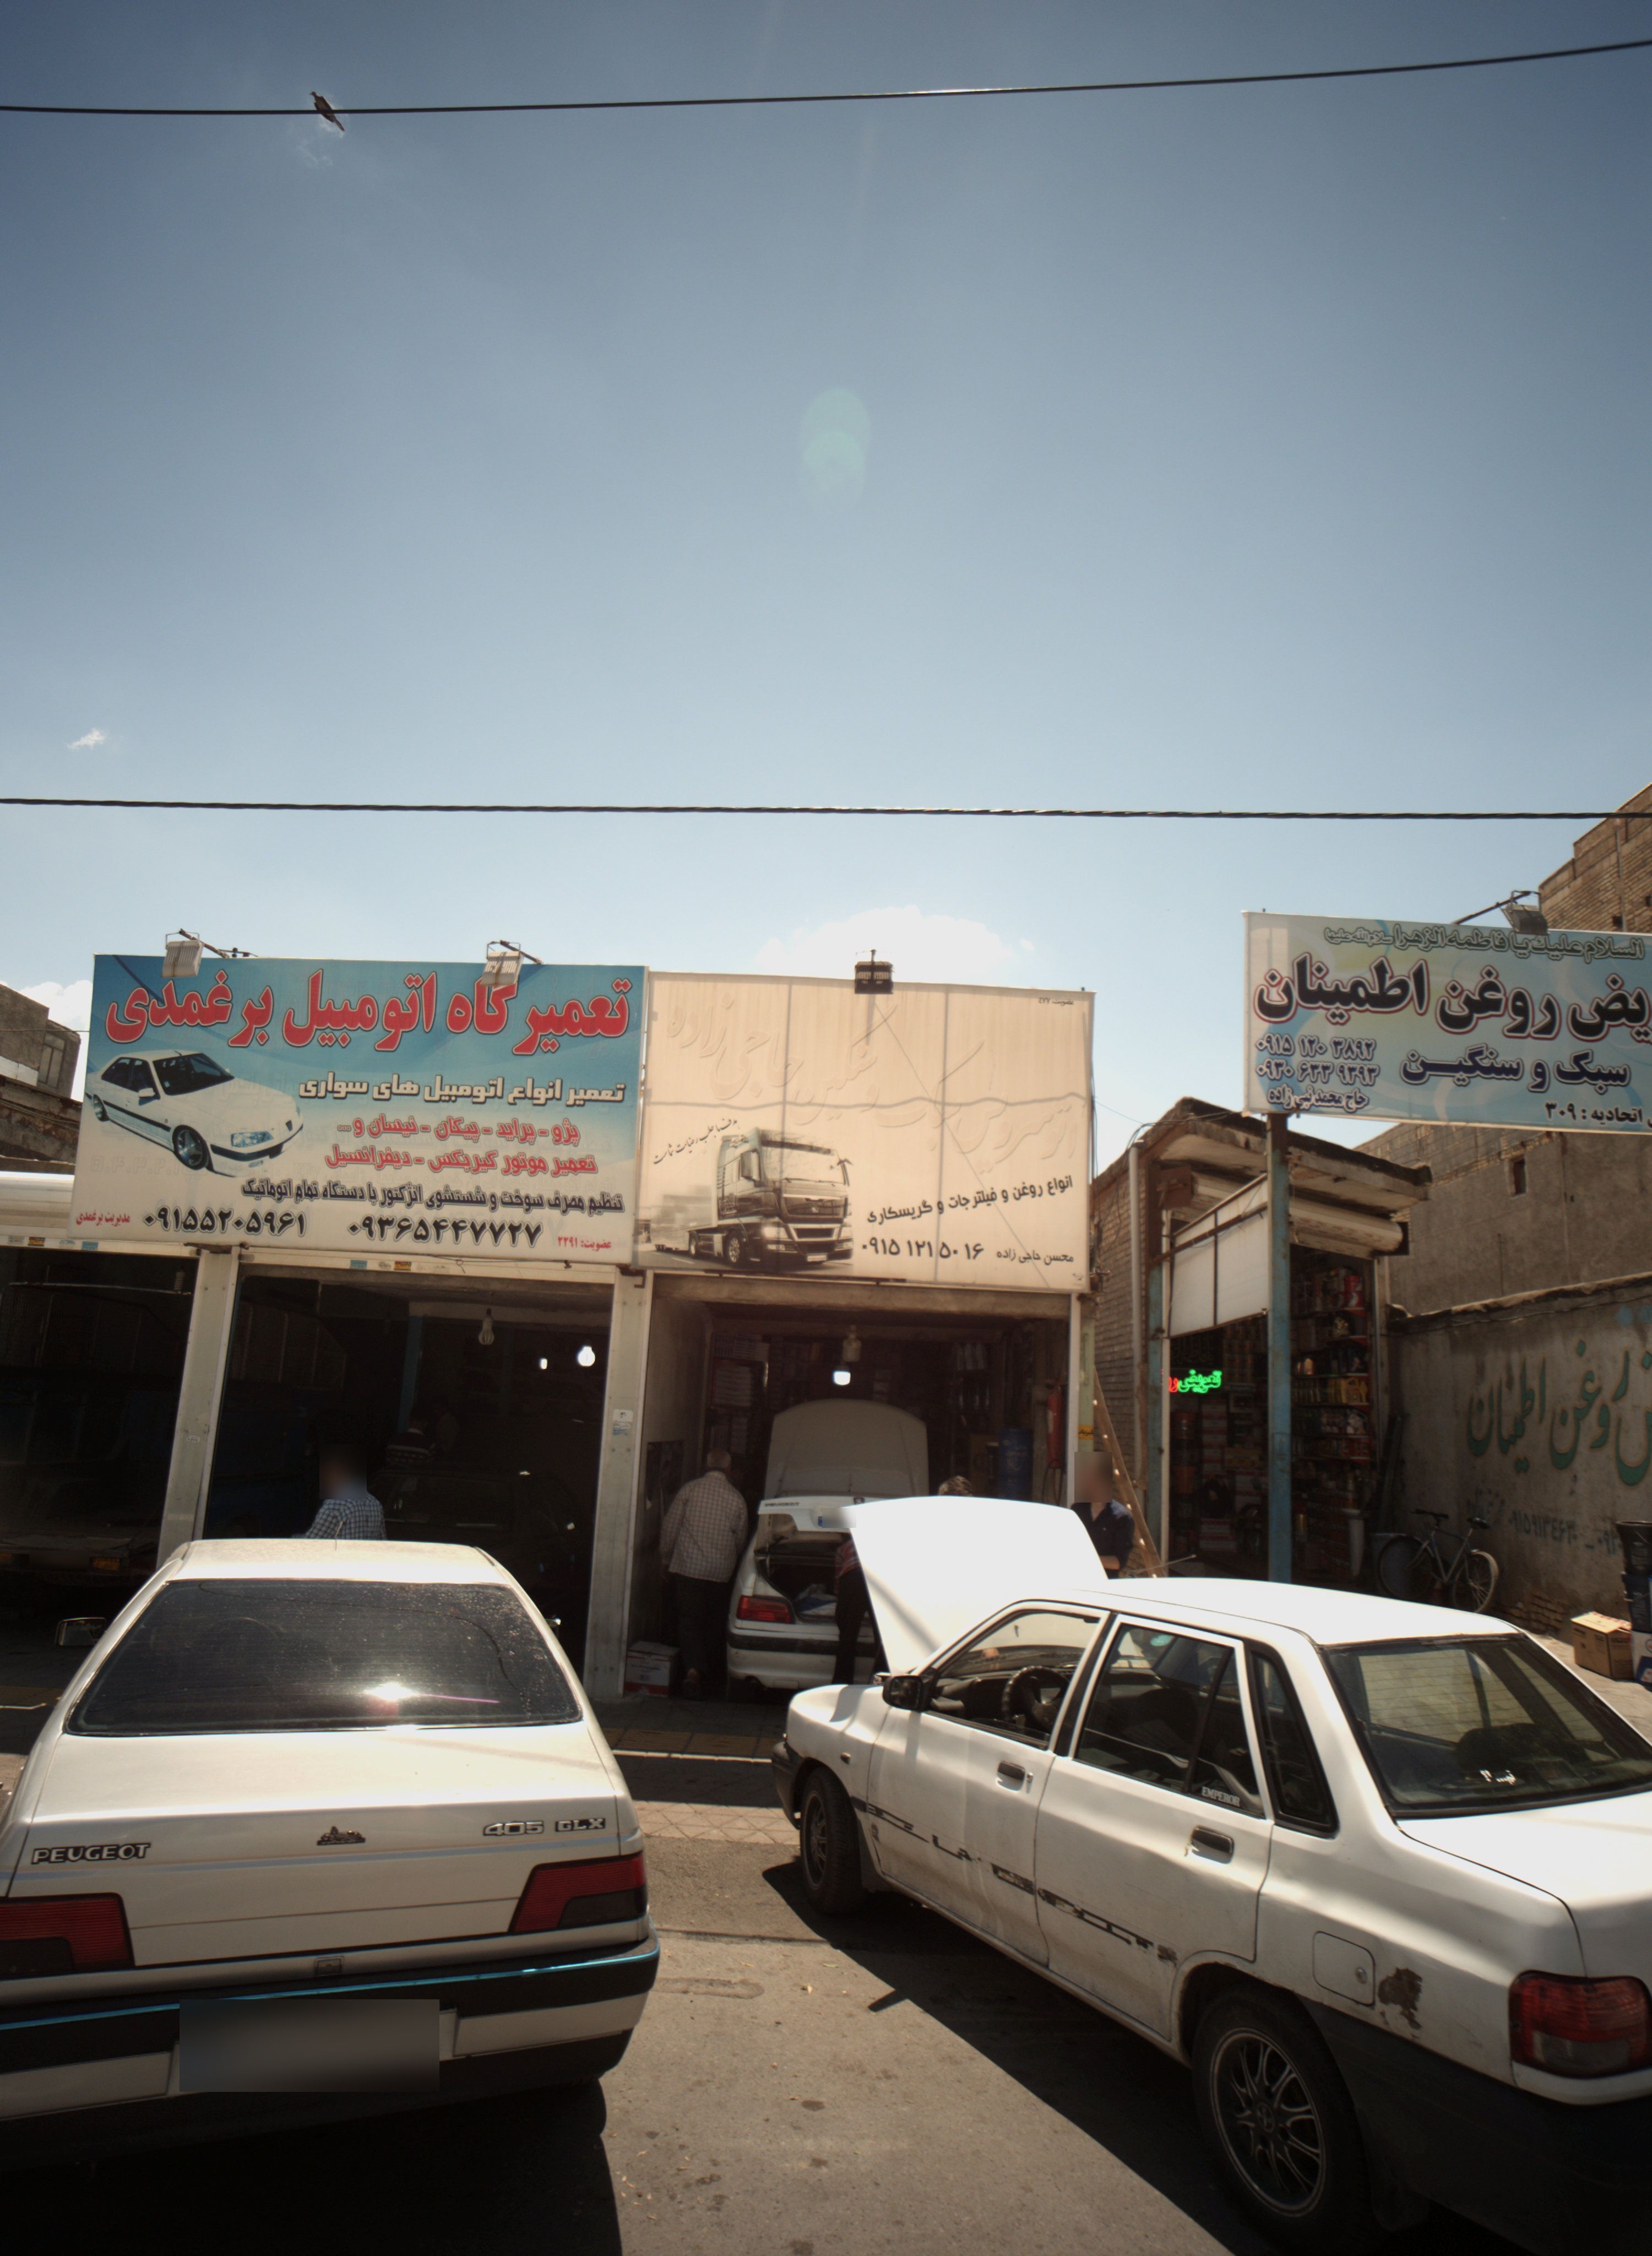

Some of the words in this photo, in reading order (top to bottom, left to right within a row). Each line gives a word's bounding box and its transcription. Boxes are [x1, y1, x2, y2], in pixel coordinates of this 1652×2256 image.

[1253, 952, 1431, 1026] اطمینان
[282, 968, 437, 1051] اتومبیل
[1436, 965, 1562, 1041] روغن
[1400, 1043, 1524, 1086] سنگین
[1528, 1060, 1551, 1092] و
[1554, 1049, 1631, 1094] سبک
[298, 1071, 369, 1099] سواری
[372, 1073, 419, 1100] های
[423, 1075, 504, 1103] اتومبیل
[507, 1077, 562, 1105] انواع
[566, 1082, 626, 1107] تعمیر
[1545, 1102, 1577, 1121] ۳۰۹
[1590, 1107, 1643, 1125] اتحادیه
[352, 1118, 365, 1137] و
[367, 1113, 419, 1138] نیسان
[434, 1115, 480, 1143] پیکان
[496, 1118, 537, 1145] پراید
[551, 1118, 581, 1146] پژو
[325, 1143, 412, 1170] دیفرانسیل
[502, 1152, 549, 1176] موتور
[551, 1155, 599, 1178] تعمیر
[241, 1178, 294, 1203] اتوماتیک
[294, 1179, 319, 1203] تمام
[321, 1179, 367, 1201] دستگاه
[366, 1181, 378, 1206] با
[379, 1181, 424, 1208] انژکتور
[425, 1184, 488, 1210] شستشوی
[1001, 1189, 1009, 1203] و
[1012, 1181, 1044, 1201] روغن
[1047, 1175, 1074, 1196] انواع
[499, 1188, 545, 1214] سوخت
[546, 1190, 586, 1216] مصرف
[587, 1189, 626, 1217] تنظیم
[143, 1205, 307, 1237] ۰۹۱۵۵۲۰۵۹۶۱
[348, 1214, 544, 1248] ۰۹۳۶۵۴۴۷۷۲۷
[1044, 1250, 1075, 1266] محسن
[1178, 1369, 1222, 1394] تعویض
[1201, 1786, 1241, 1807] EMPEROR
[483, 1820, 545, 1836] 405
[555, 1818, 605, 1832] GLX
[31, 1842, 150, 1864] PEUGEOT
